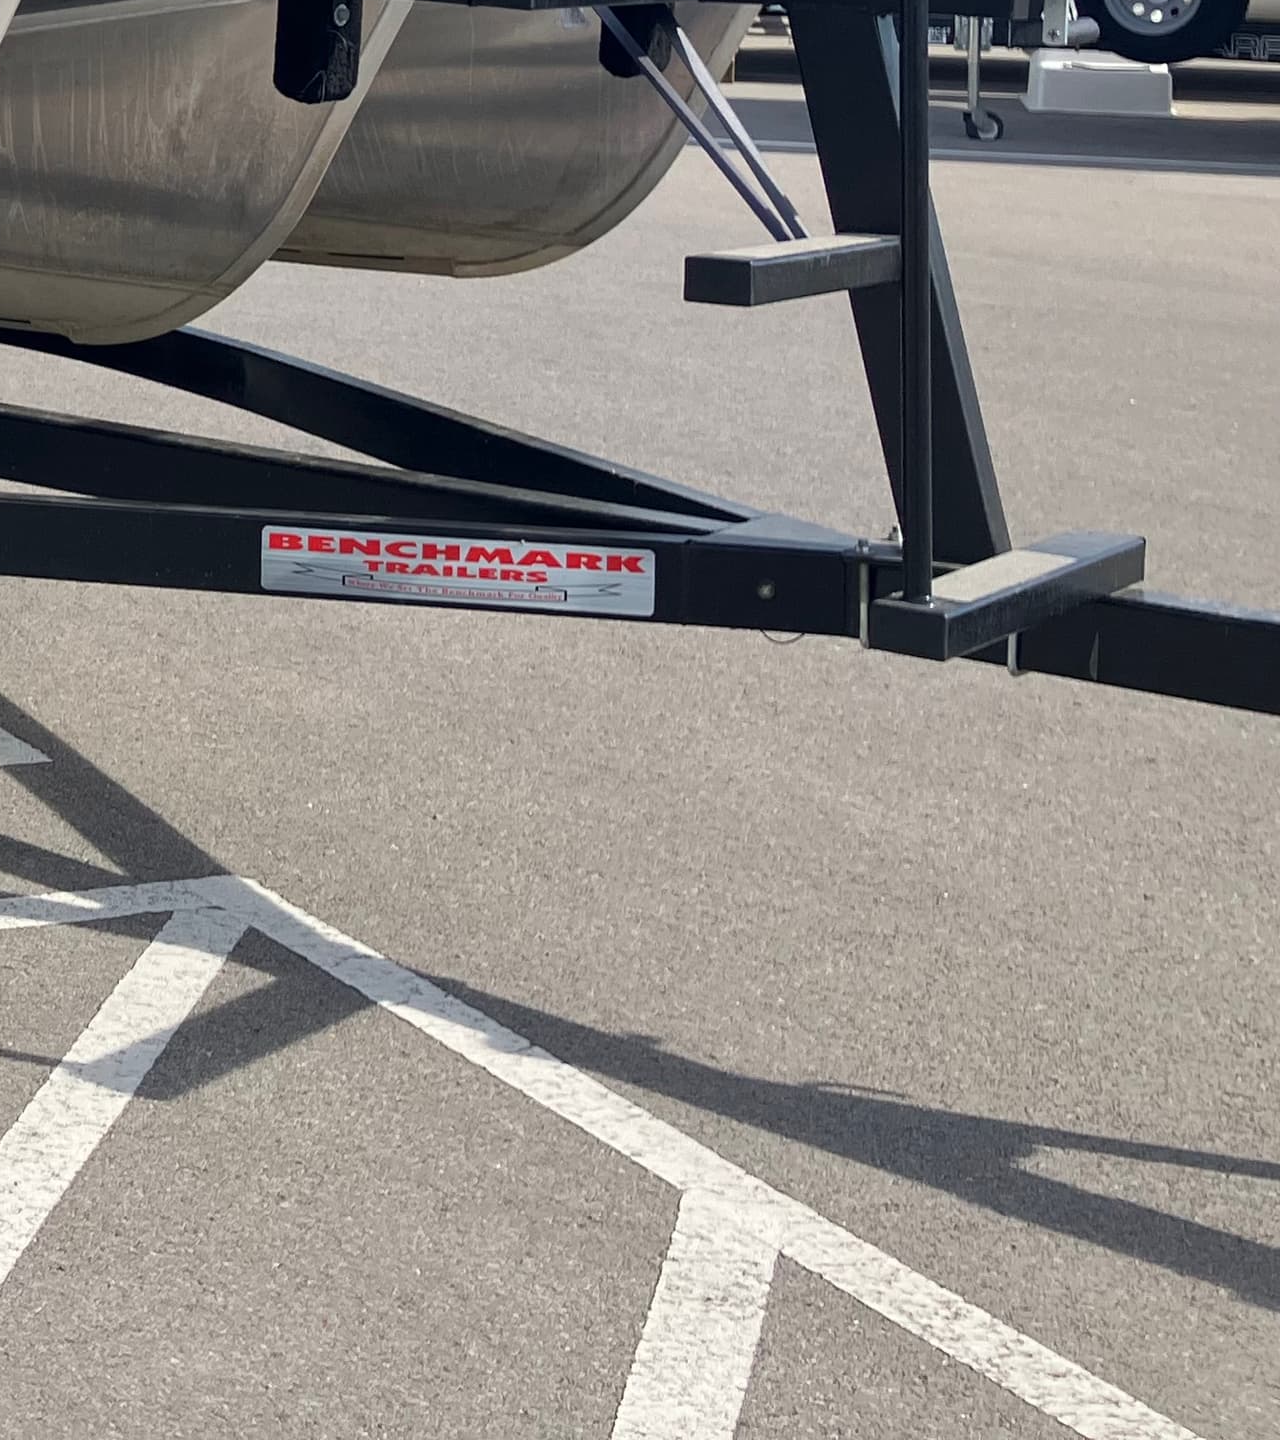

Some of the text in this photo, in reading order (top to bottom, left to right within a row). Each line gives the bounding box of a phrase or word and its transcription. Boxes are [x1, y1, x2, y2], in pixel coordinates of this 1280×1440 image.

[267, 532, 646, 574] BENCHMARK
[362, 560, 549, 583] TRAILERS
[441, 587, 504, 600] Benchmark
